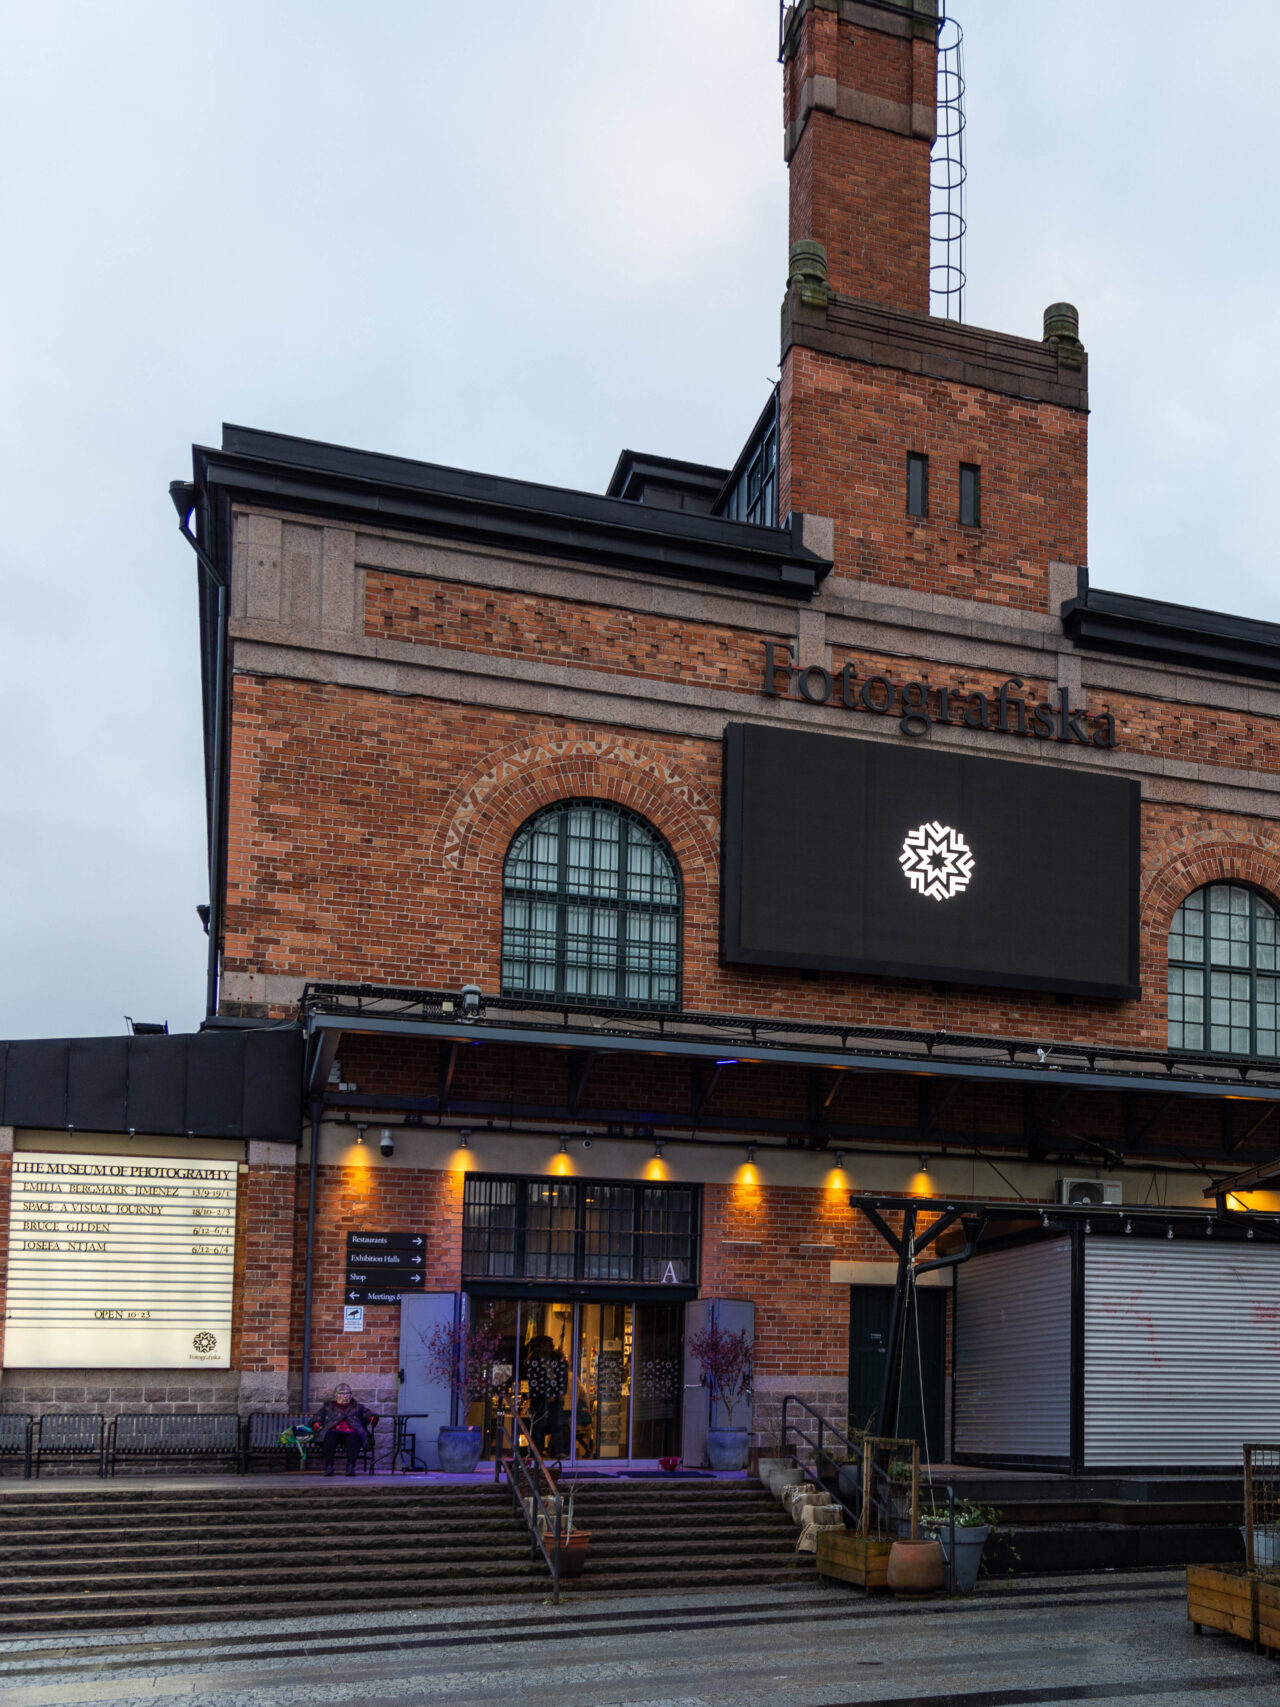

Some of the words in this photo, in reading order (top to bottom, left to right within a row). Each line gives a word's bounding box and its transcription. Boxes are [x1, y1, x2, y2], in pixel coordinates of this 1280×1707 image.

[760, 640, 1119, 748] Fotografiska
[14, 1162, 44, 1174] THE
[47, 1163, 107, 1176] MUSEUM
[109, 1165, 129, 1177] OF
[130, 1166, 231, 1180] PHOTOGRAPHY
[23, 1182, 62, 1193] EMILIA
[71, 1203, 111, 1214] VISUAL
[116, 1205, 163, 1216] JOURNEY
[23, 1220, 60, 1231] BRUCE
[66, 1222, 110, 1233] GILDEN
[351, 1235, 388, 1244] Restaurants
[22, 1240, 61, 1251] JOSEFA
[67, 1242, 107, 1252] NTJAM
[351, 1254, 383, 1263] Exhibition
[384, 1255, 400, 1263] Halls
[660, 1260, 680, 1284] A
[350, 1273, 367, 1283] Shop
[367, 1292, 396, 1302] Meetings
[94, 1309, 123, 1320] OPEN
